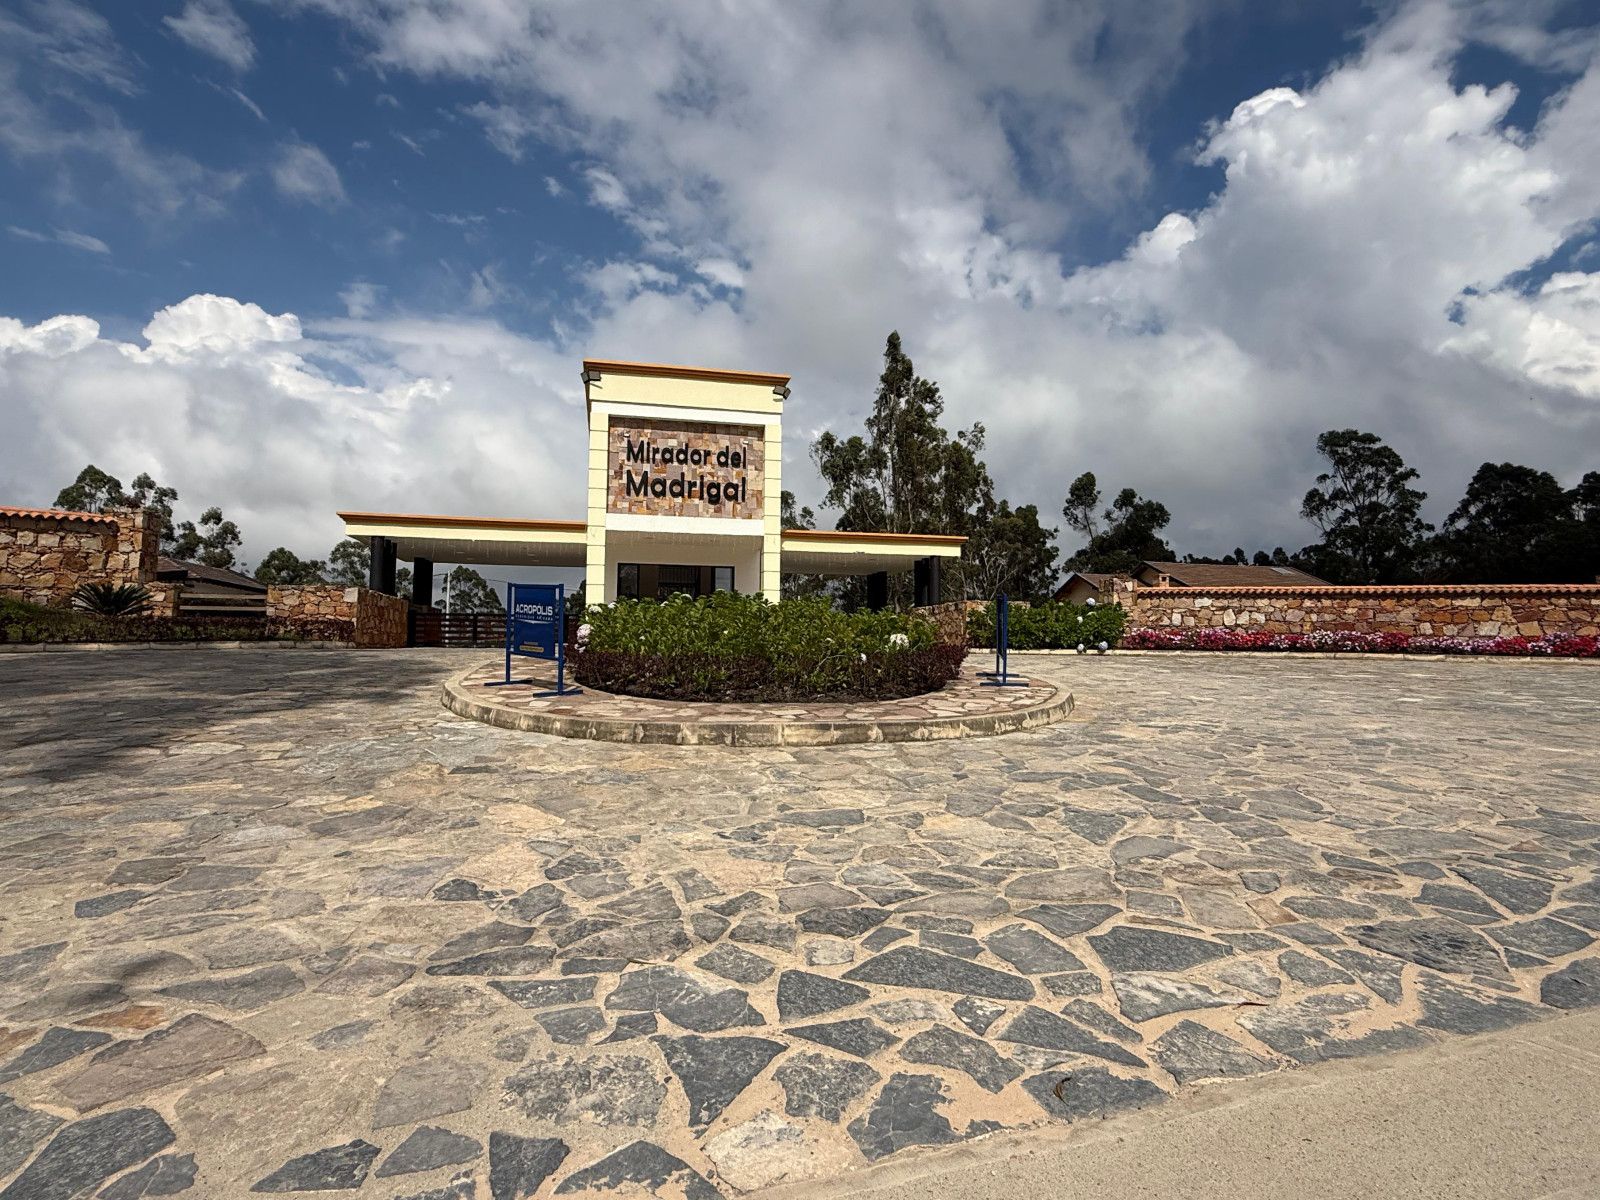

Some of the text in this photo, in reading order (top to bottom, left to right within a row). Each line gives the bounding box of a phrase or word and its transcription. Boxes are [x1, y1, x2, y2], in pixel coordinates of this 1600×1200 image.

[626, 439, 747, 469] Mirador del
[626, 469, 746, 505] Madrigal
